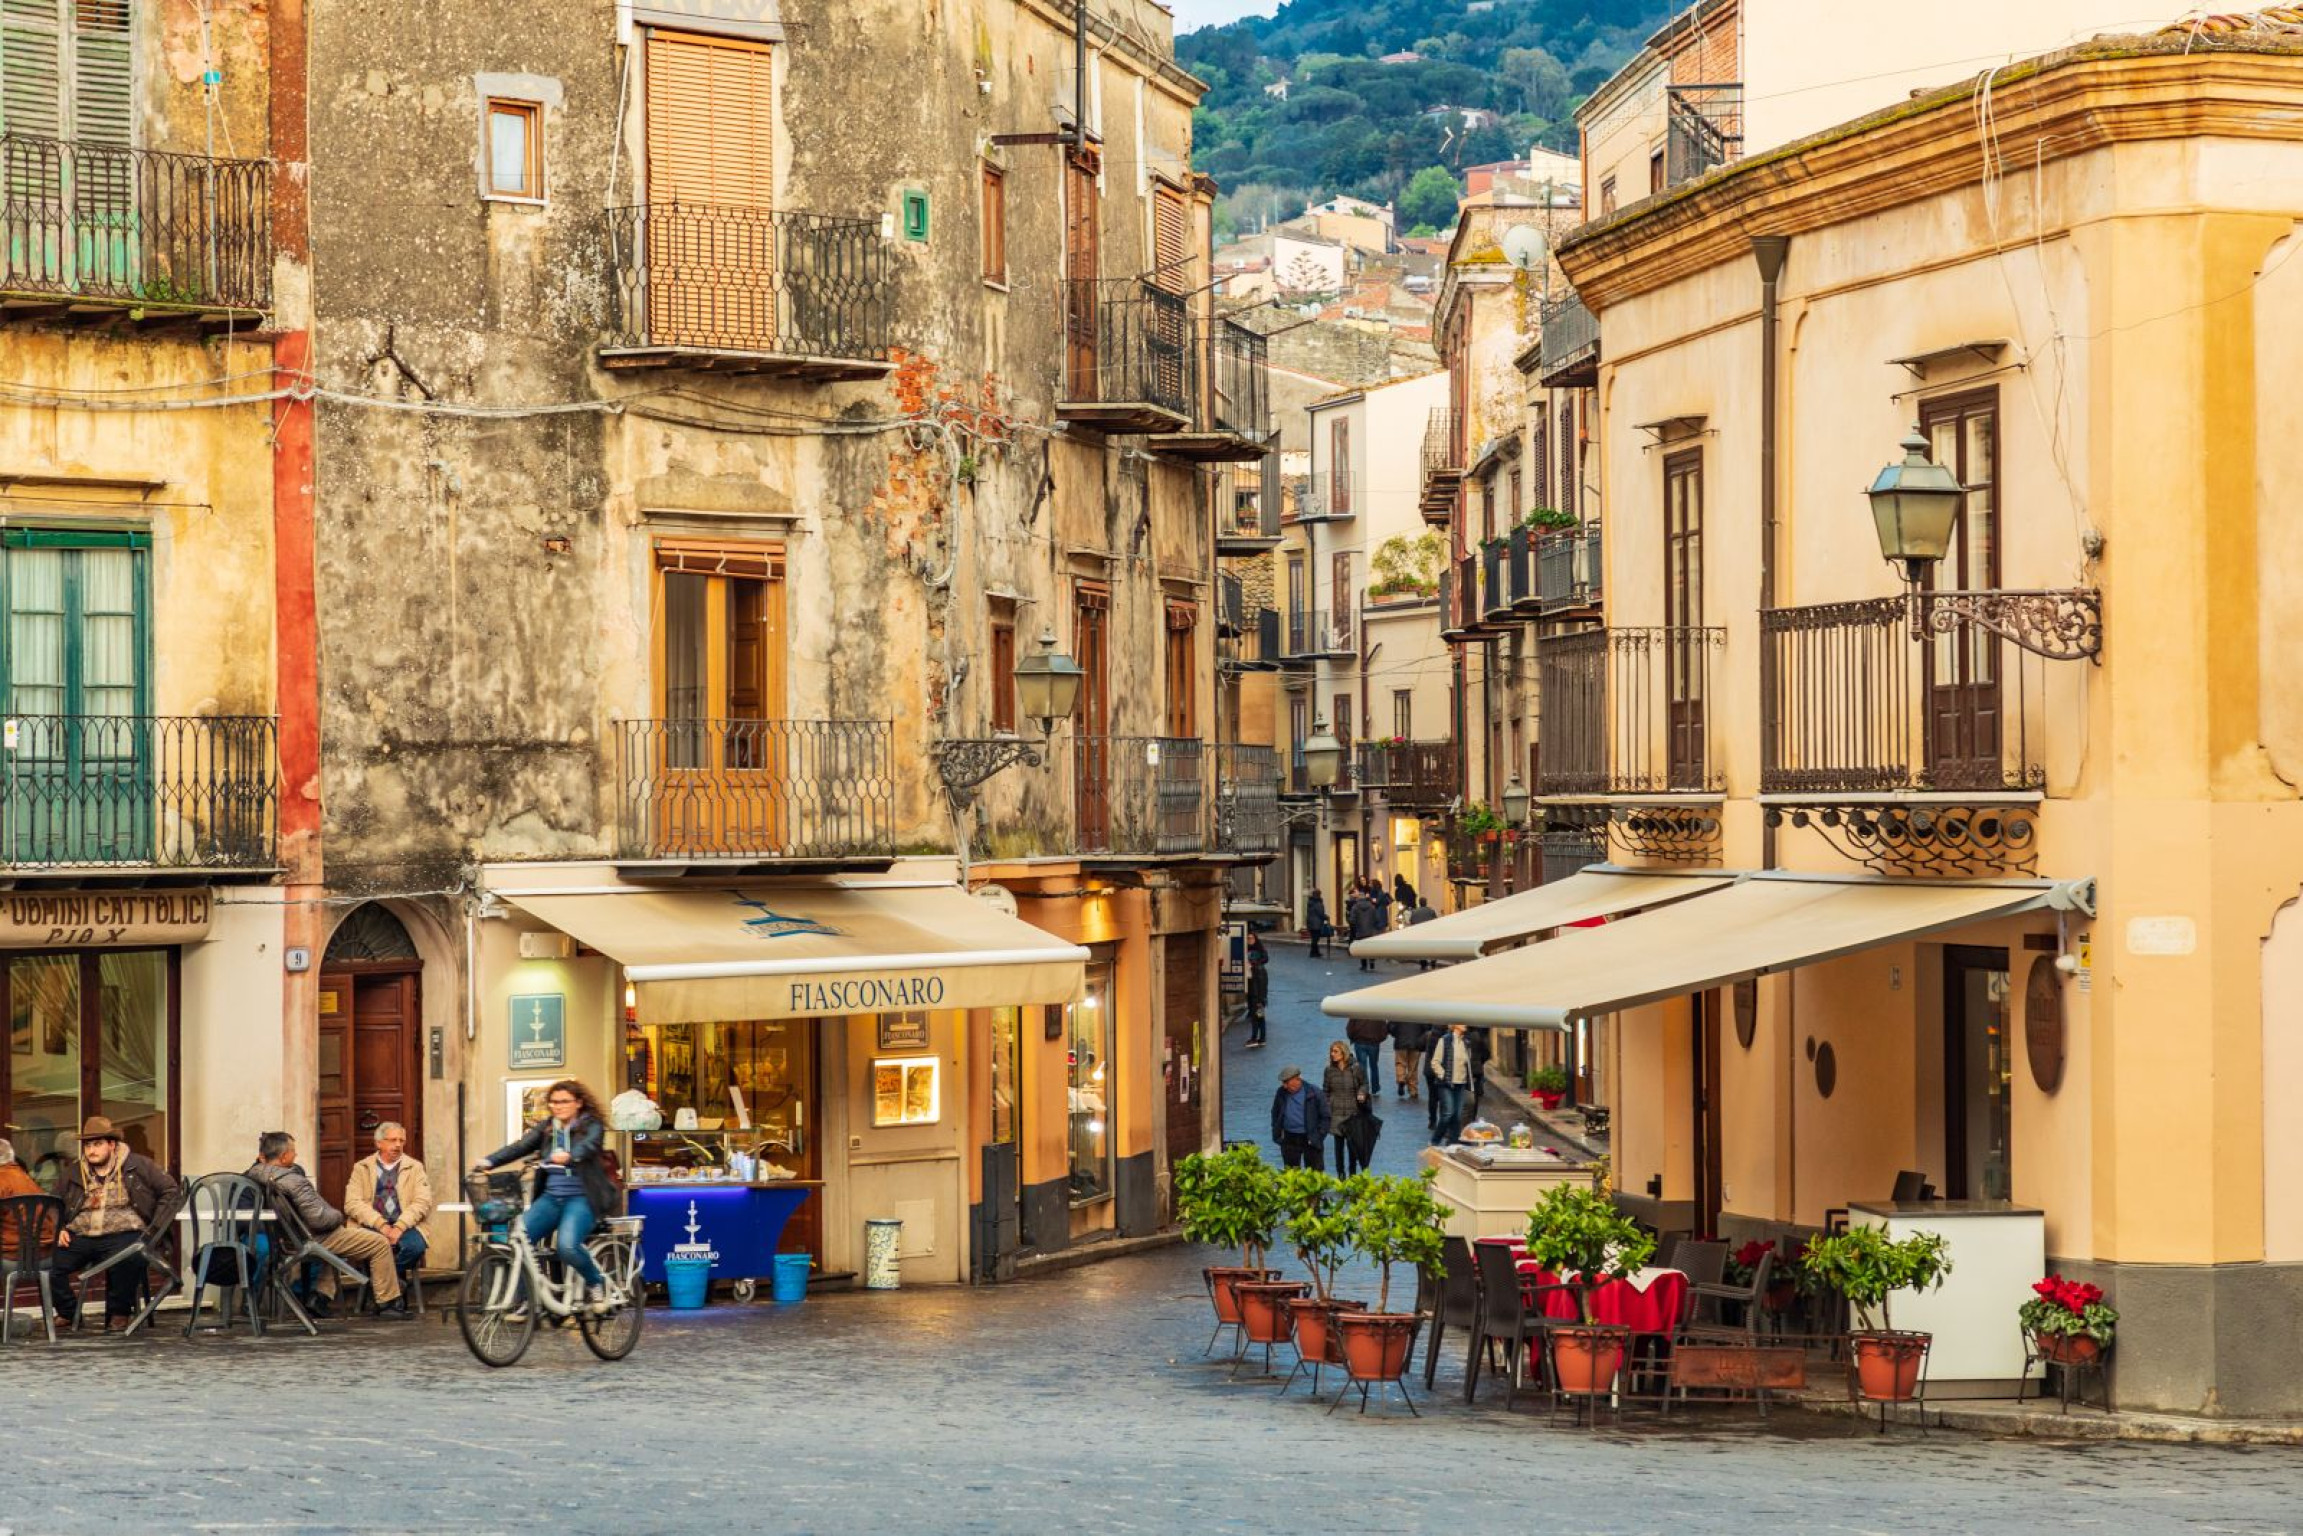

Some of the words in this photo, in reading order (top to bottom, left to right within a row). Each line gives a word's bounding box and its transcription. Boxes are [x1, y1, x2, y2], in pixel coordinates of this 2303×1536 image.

[11, 896, 88, 925] UOMINI
[95, 895, 208, 924] CATTOLICI
[45, 928, 94, 944] PIO
[102, 928, 127, 943] X
[790, 976, 944, 1011] FIASCONARO
[513, 1048, 561, 1059] FIASCONARO
[667, 1251, 720, 1261] FIASCONARO
